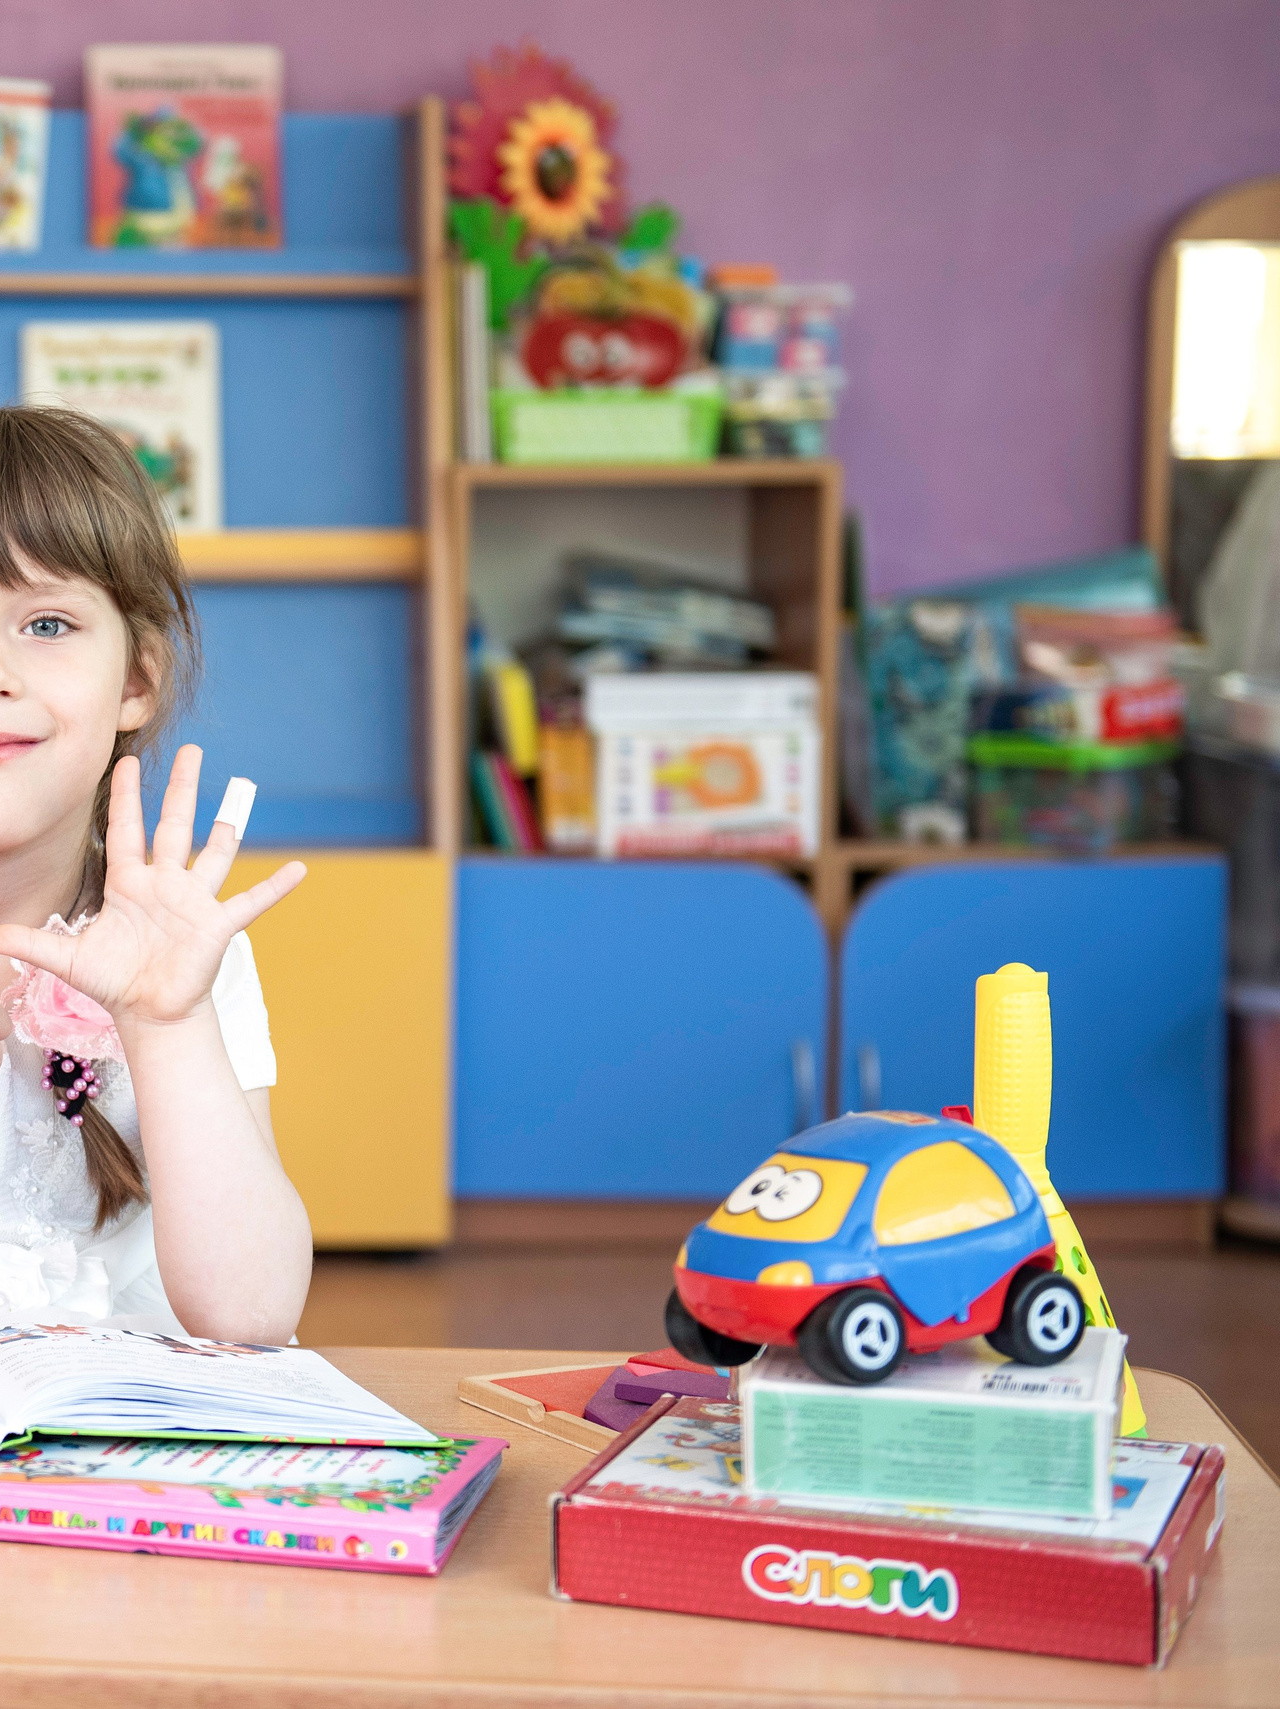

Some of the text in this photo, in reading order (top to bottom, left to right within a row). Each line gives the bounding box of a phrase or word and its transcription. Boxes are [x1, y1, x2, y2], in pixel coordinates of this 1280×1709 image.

[107, 1516, 126, 1533] И
[132, 1518, 228, 1543] ДРУГИЕ
[233, 1527, 336, 1553] СКАЗКИ
[746, 1548, 954, 1618] СЛОГИ
